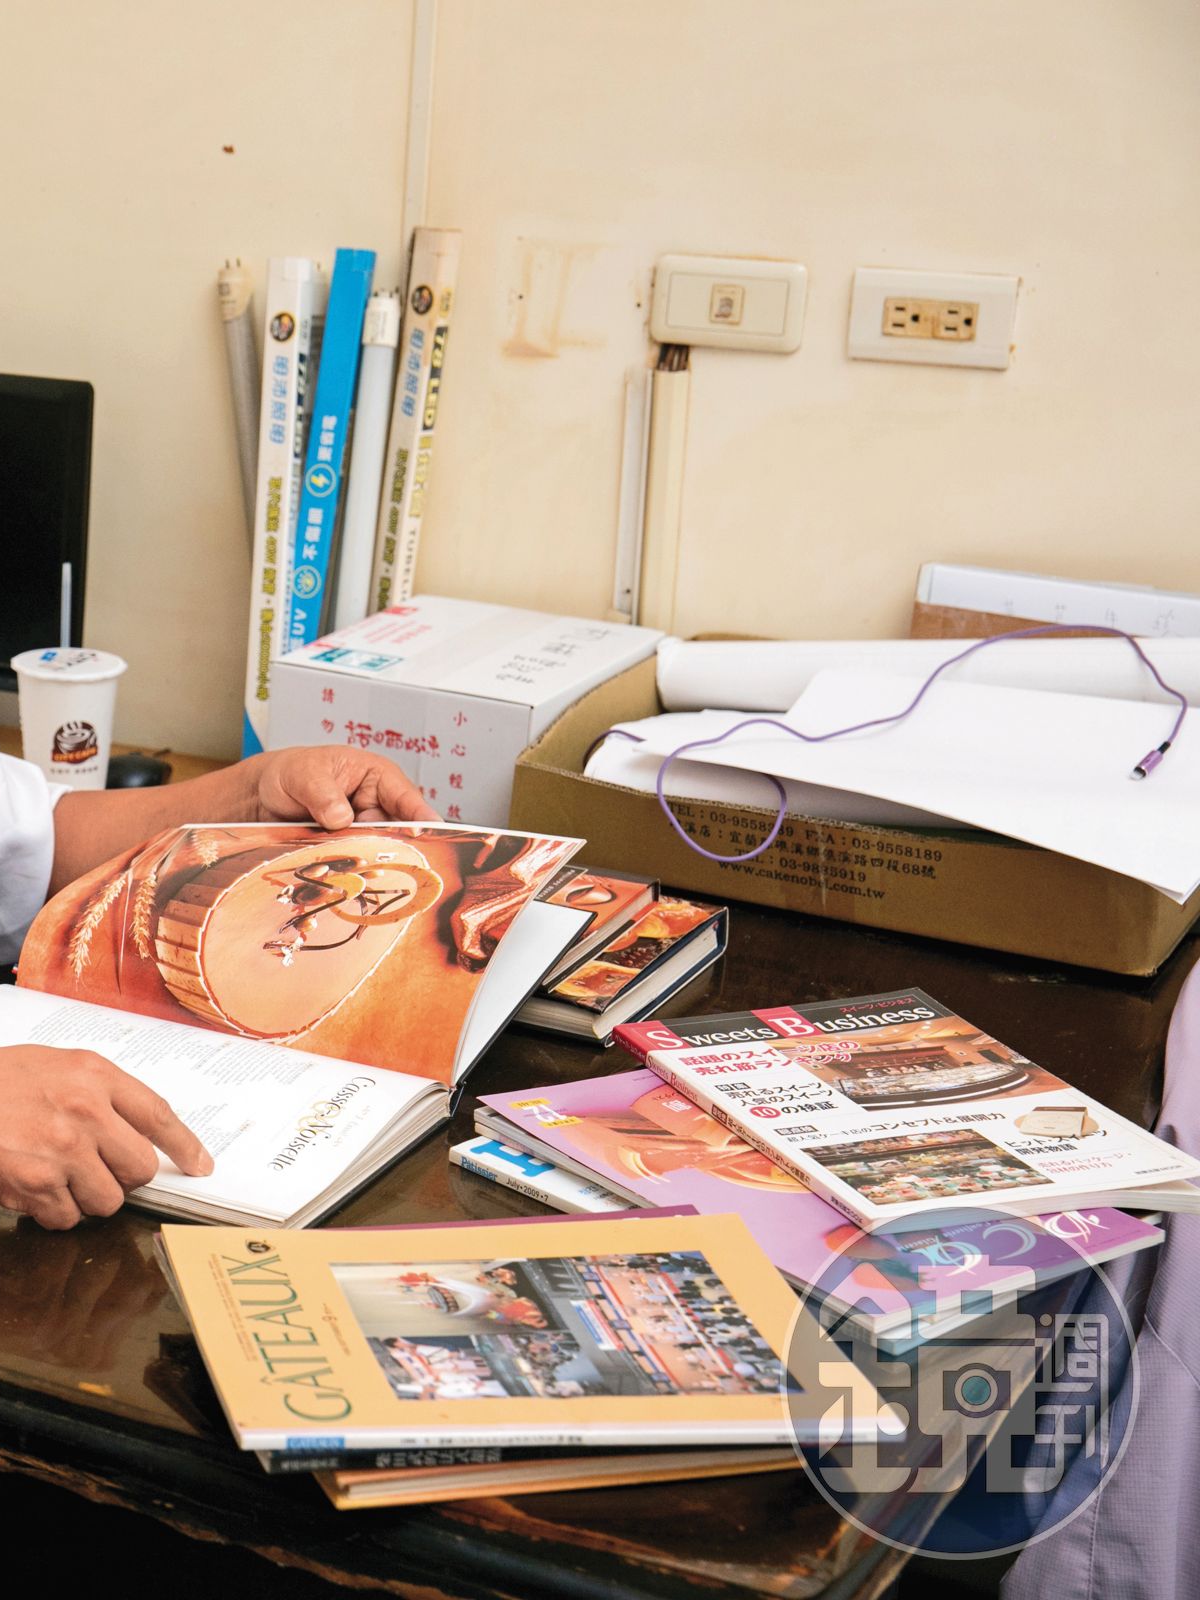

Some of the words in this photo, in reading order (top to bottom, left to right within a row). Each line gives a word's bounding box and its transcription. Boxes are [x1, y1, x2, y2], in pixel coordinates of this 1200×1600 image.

[424, 378, 440, 428] LED
[448, 711, 468, 820] 小心輕放
[646, 1025, 777, 1050] Sweets
[767, 1005, 936, 1038] Business
[678, 1040, 861, 1067] 話題のスイーツ店の
[695, 1052, 853, 1077] 売れ筋ランキング
[726, 1081, 823, 1099] 売れるスイーツ
[740, 1089, 834, 1107] 人気のスイーツ
[1015, 1142, 1078, 1156] 開発物語
